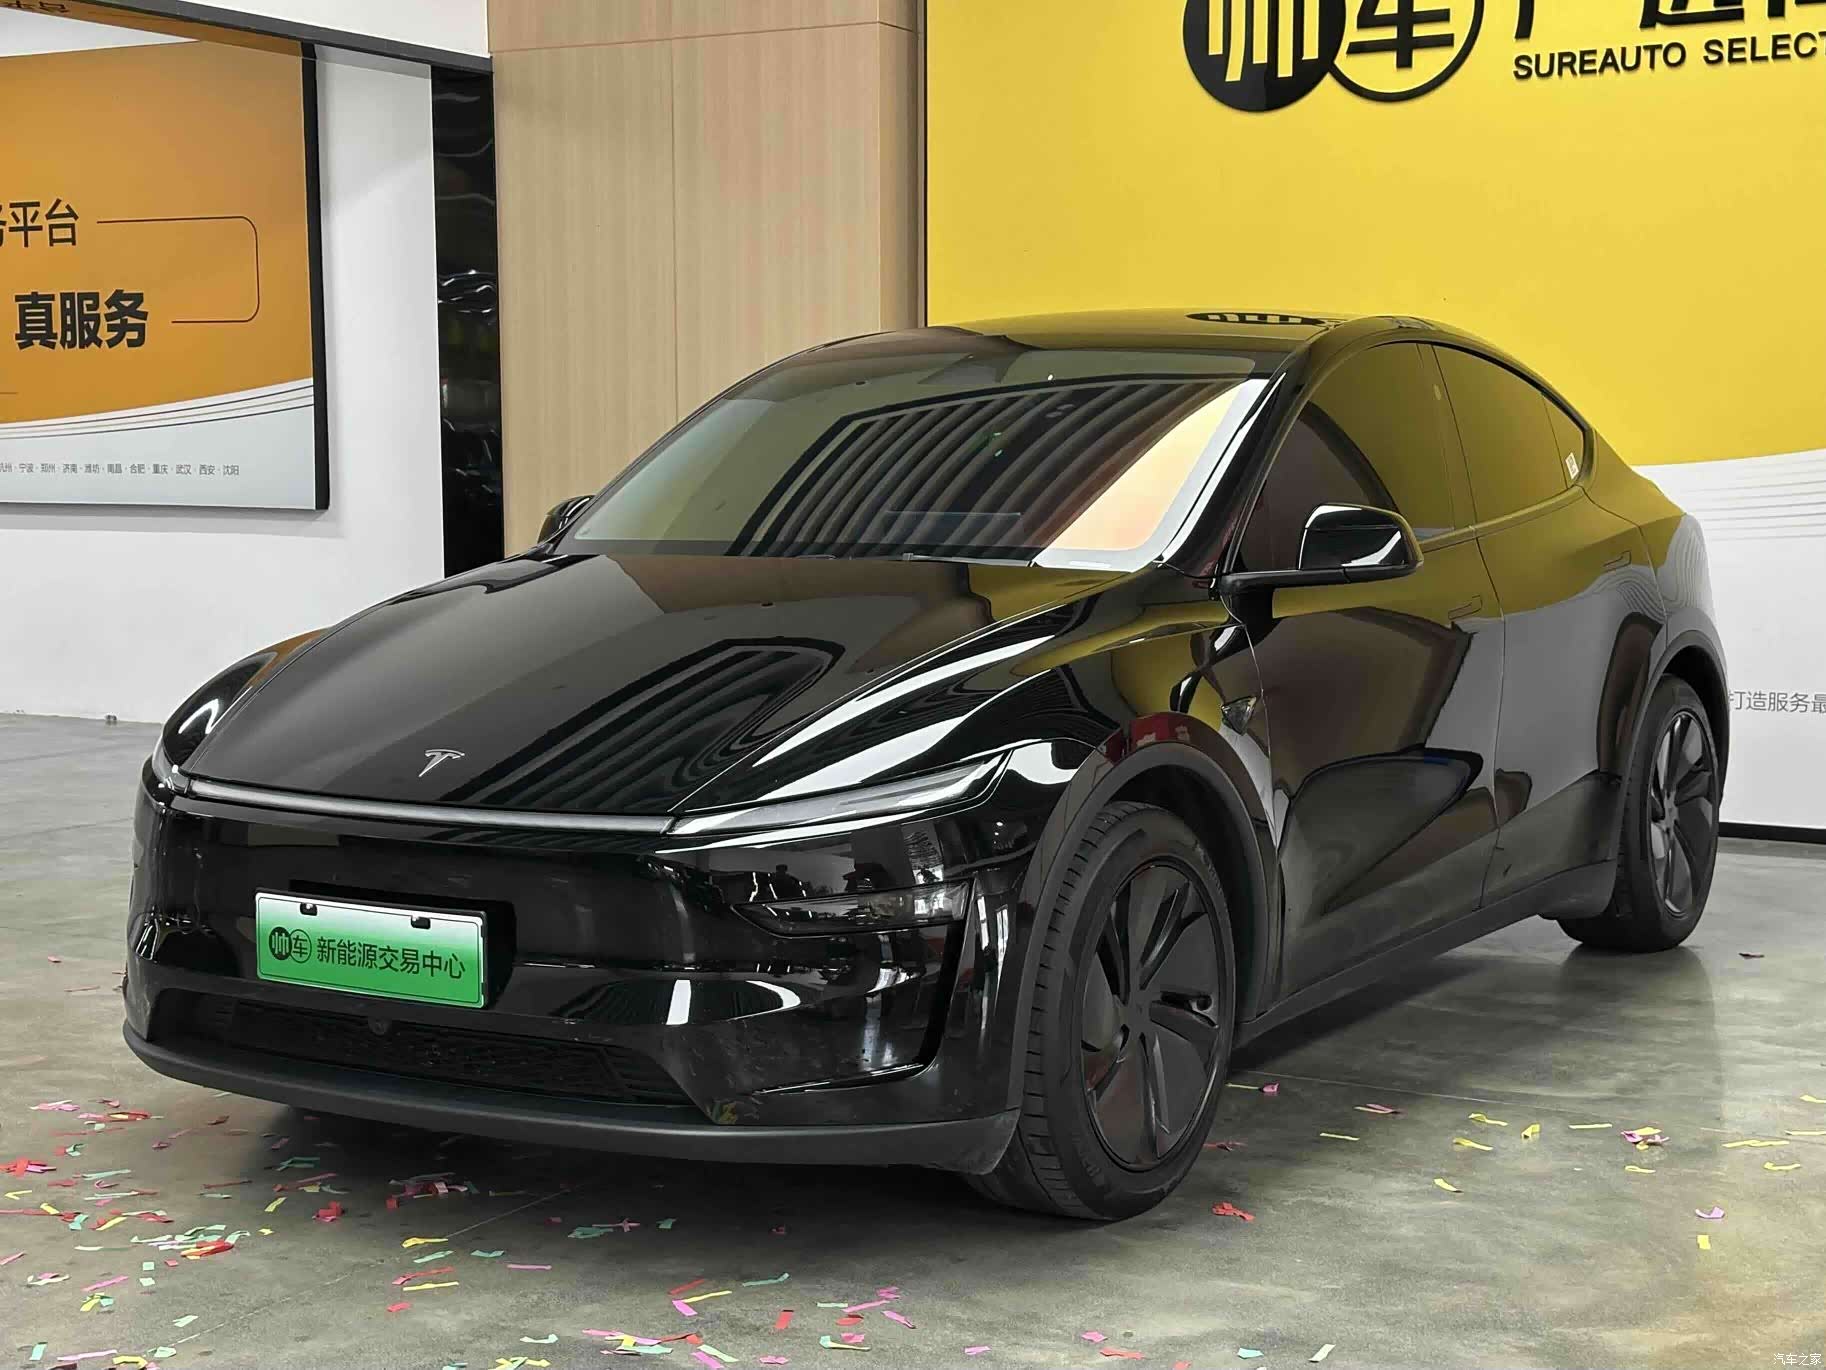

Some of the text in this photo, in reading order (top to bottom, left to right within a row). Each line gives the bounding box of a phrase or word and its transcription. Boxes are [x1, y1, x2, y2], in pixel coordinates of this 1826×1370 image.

[1513, 41, 1687, 80] SUREAUTO
[0, 198, 79, 248] 平台
[14, 289, 149, 350] 真服务
[316, 936, 466, 979] 新能源交易中心
